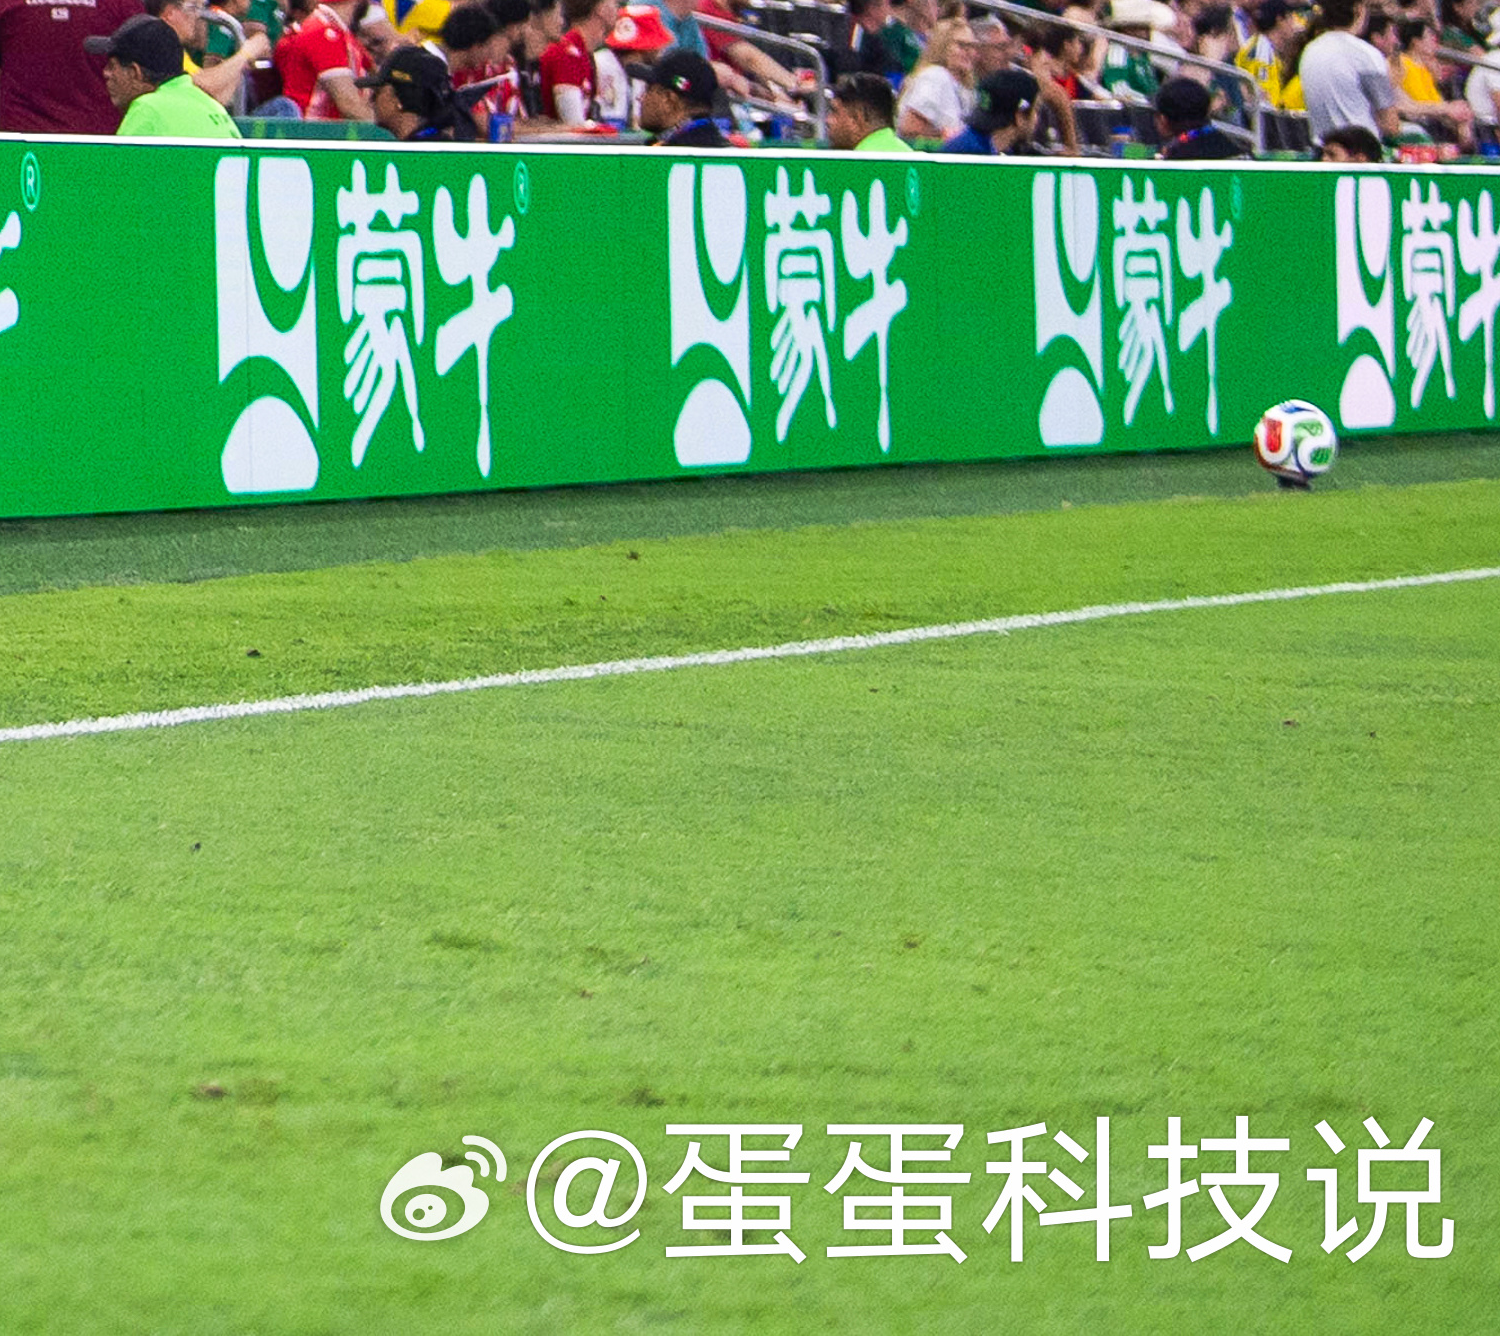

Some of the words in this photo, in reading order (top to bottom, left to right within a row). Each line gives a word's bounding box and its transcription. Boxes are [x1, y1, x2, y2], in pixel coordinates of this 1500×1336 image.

[336, 159, 516, 480] 蒙牛
[763, 165, 910, 453] 蒙牛
[1111, 174, 1234, 436] 蒙牛
[1400, 177, 1500, 421] 蒙牛
